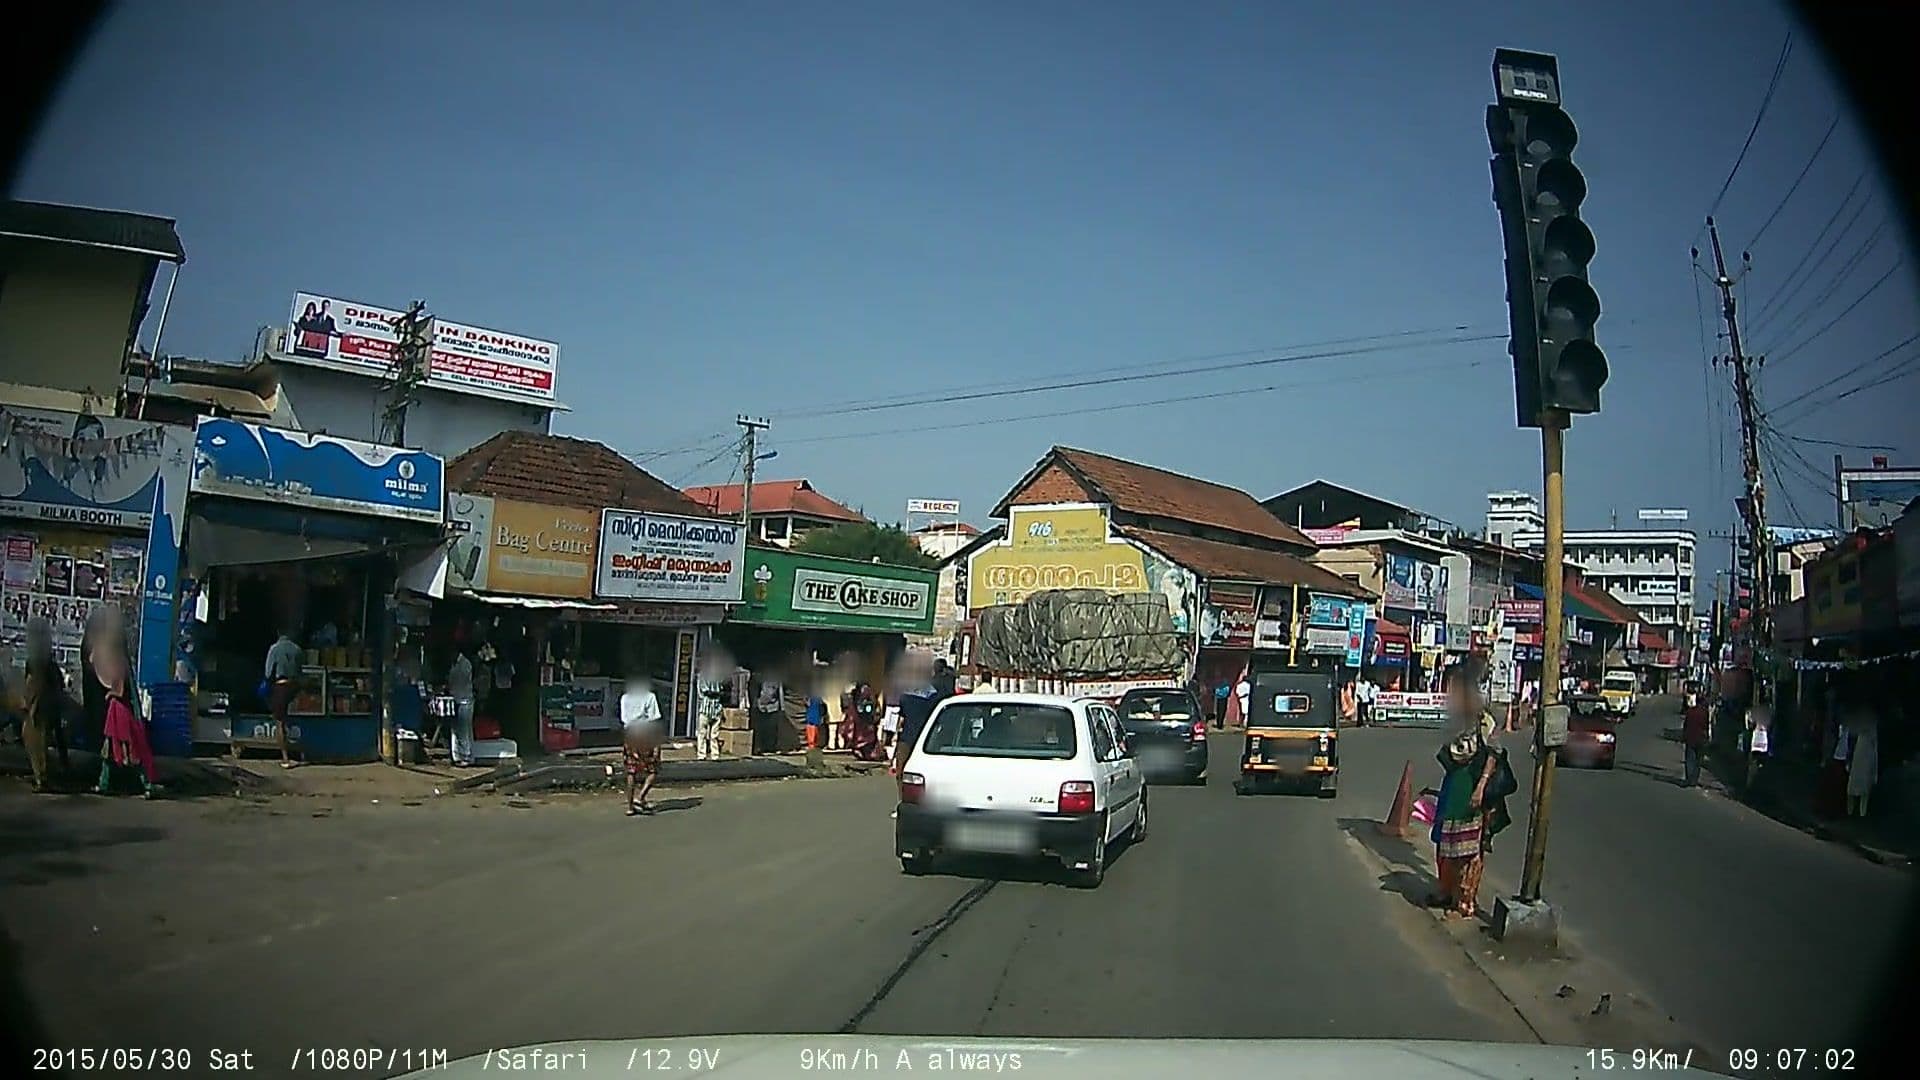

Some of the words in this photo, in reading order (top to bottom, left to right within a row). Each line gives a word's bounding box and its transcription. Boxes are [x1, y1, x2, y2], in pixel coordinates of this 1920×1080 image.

[439, 326, 459, 337] IN
[465, 331, 551, 354] BANKING
[385, 478, 427, 493] milma
[40, 506, 79, 520] MILMA
[80, 508, 122, 525] BOOTH
[496, 526, 529, 553] Bag
[536, 527, 592, 555] Centre
[1029, 521, 1052, 537] 916
[805, 582, 836, 601] THE
[839, 580, 879, 610] CAKE
[880, 590, 919, 608] SHOP
